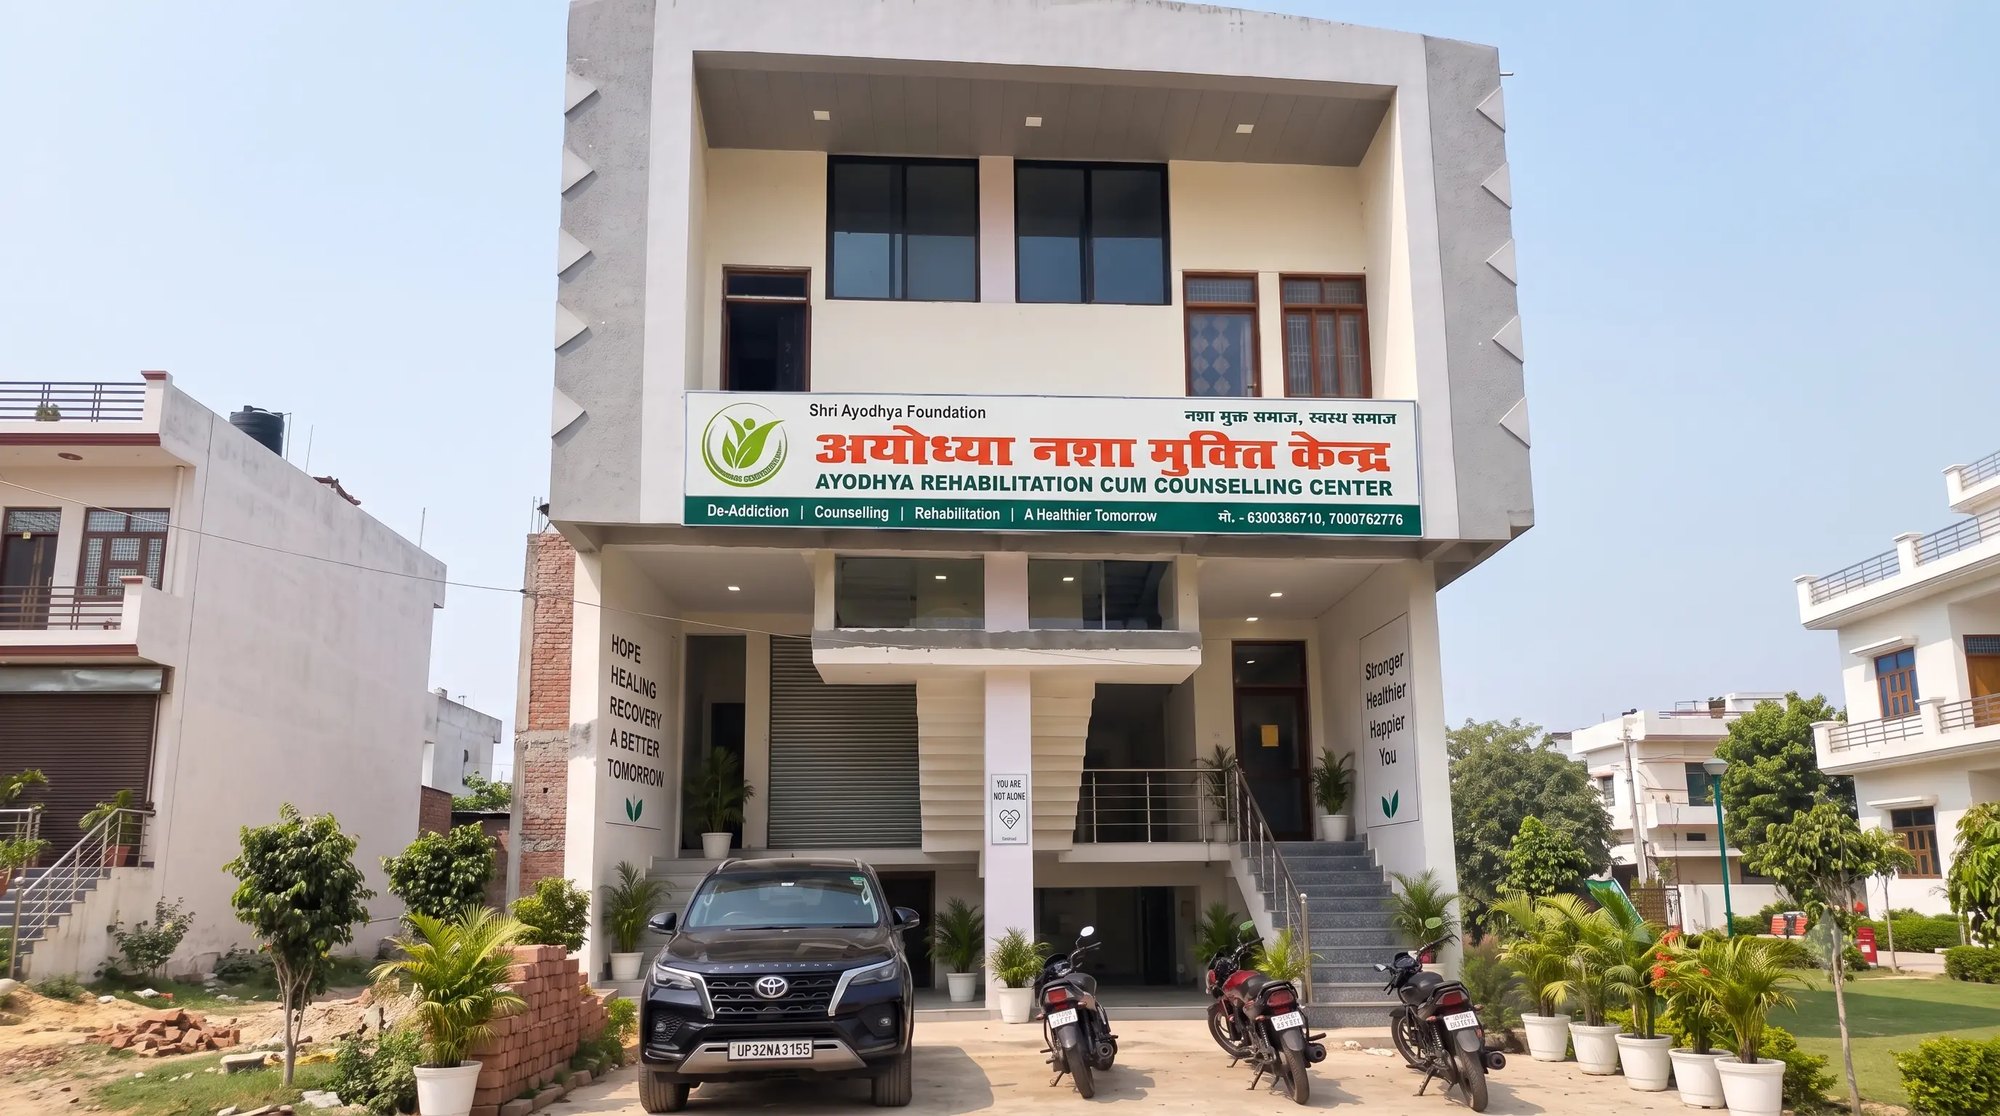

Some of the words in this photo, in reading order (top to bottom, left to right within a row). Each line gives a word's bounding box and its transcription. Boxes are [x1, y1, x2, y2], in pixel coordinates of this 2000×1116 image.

[810, 404, 838, 417] Shri
[841, 404, 902, 420] Ayodhya
[907, 406, 986, 419] Foundation
[1185, 410, 1214, 422] नशा
[1220, 411, 1248, 426] मुक्त
[1254, 411, 1303, 426] समाज,
[1309, 412, 1347, 424] स्वस्थ
[1353, 413, 1396, 424] समाज
[815, 425, 1016, 466] अयोध्या
[1030, 436, 1137, 467] नशा
[1148, 430, 1277, 477] मुक्ति
[1289, 431, 1390, 473] केन्द्र
[815, 474, 914, 491] AYODHYA
[920, 474, 1093, 493] REHABILITATION
[1101, 477, 1146, 493] CUM
[1154, 478, 1302, 495] COUNSELLING
[1310, 480, 1393, 496] CENTER
[707, 504, 789, 517] De-Addiction
[815, 506, 889, 521] Counselling
[915, 507, 1000, 520] Rehabilitation
[1024, 509, 1034, 520] A
[1036, 508, 1092, 522] Healthier
[1095, 509, 1157, 522] Tomorrow
[1247, 512, 1325, 526] 6300386710,
[1329, 513, 1403, 525] 7000762776
[612, 634, 641, 664] HOPE
[1366, 652, 1404, 681] Stronger
[610, 664, 657, 699] HEALING
[1366, 683, 1406, 710] Healthier
[609, 695, 662, 730] RECOVERY
[1370, 715, 1405, 741] Happier
[610, 728, 617, 747] A
[621, 730, 659, 758] BETTER
[1379, 748, 1396, 767] You
[608, 758, 664, 787] TOMORROW
[997, 780, 1008, 788] YOU
[1010, 780, 1021, 788] ARE
[994, 792, 1005, 801] NOT
[1007, 792, 1026, 801] ALONE
[738, 1043, 809, 1056] UP32NA3155
